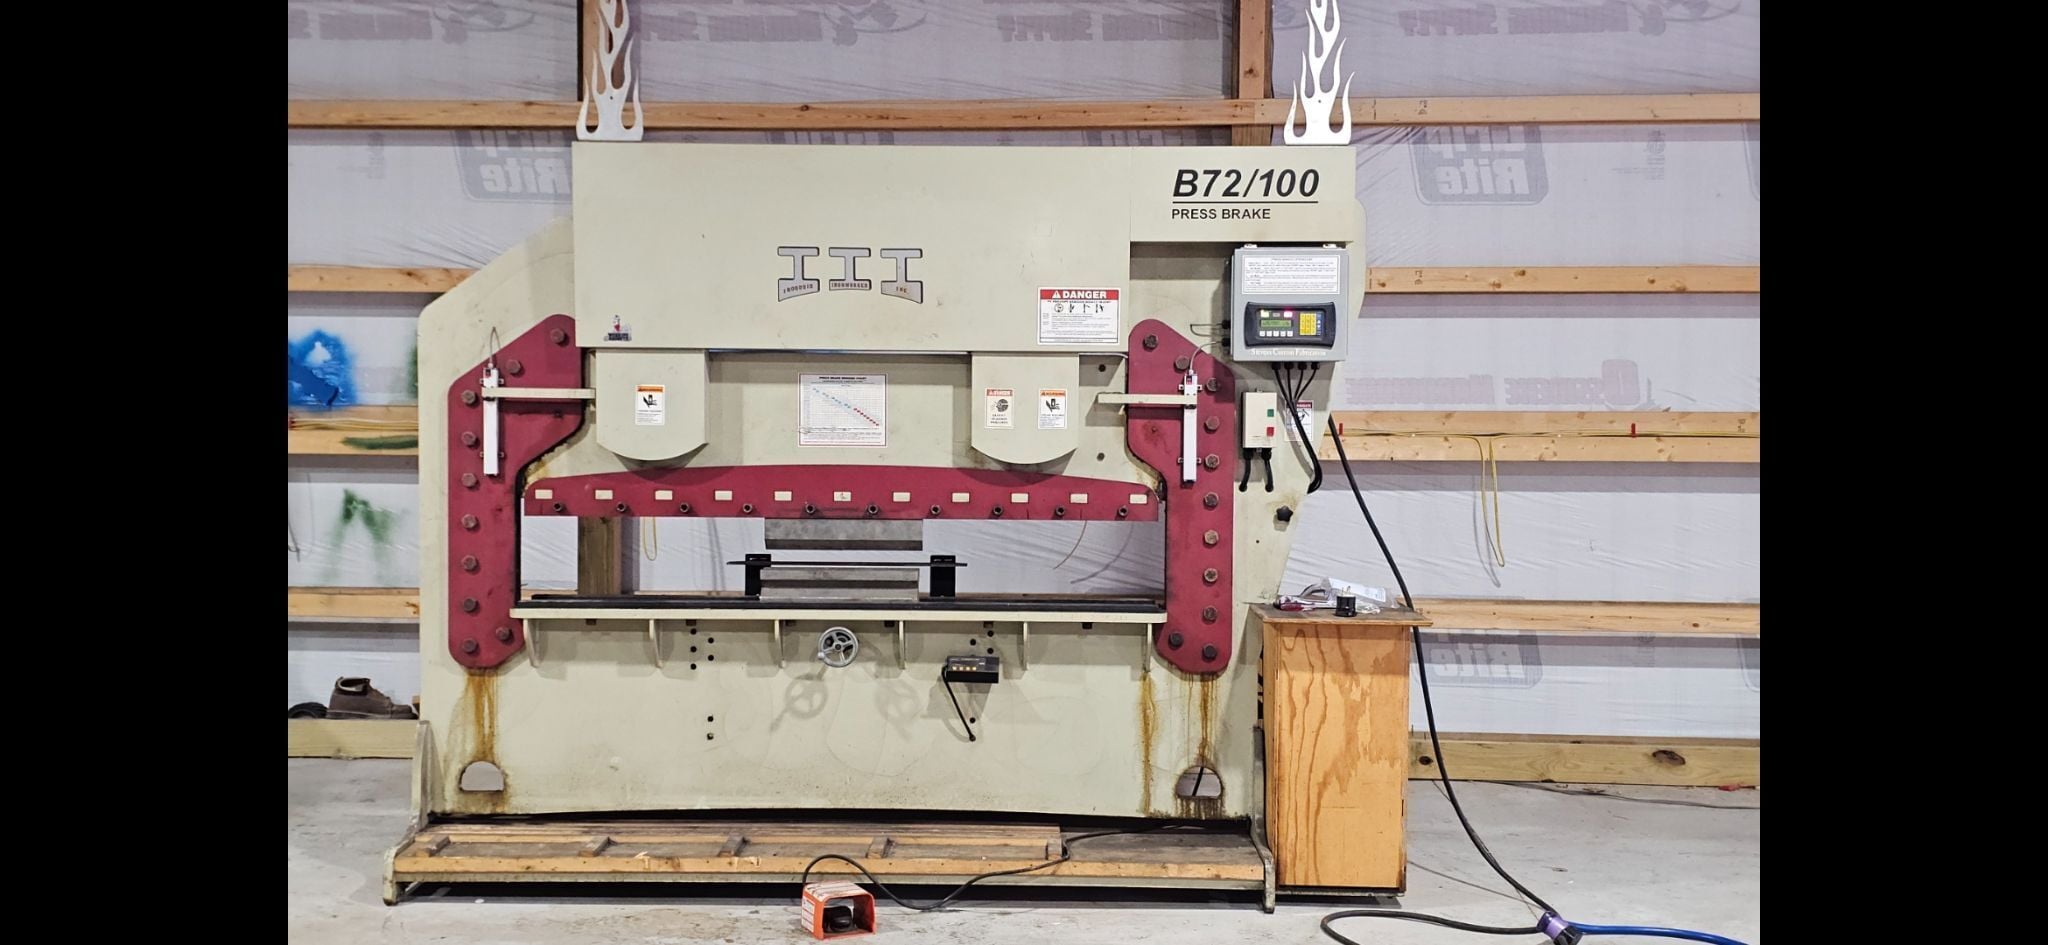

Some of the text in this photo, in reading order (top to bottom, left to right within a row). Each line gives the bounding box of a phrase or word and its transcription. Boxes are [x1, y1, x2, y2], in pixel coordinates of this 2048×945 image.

[1172, 168, 1320, 198] B72/100
[1171, 208, 1272, 220] PRESS BRAKE
[1062, 290, 1107, 299] DANGER
